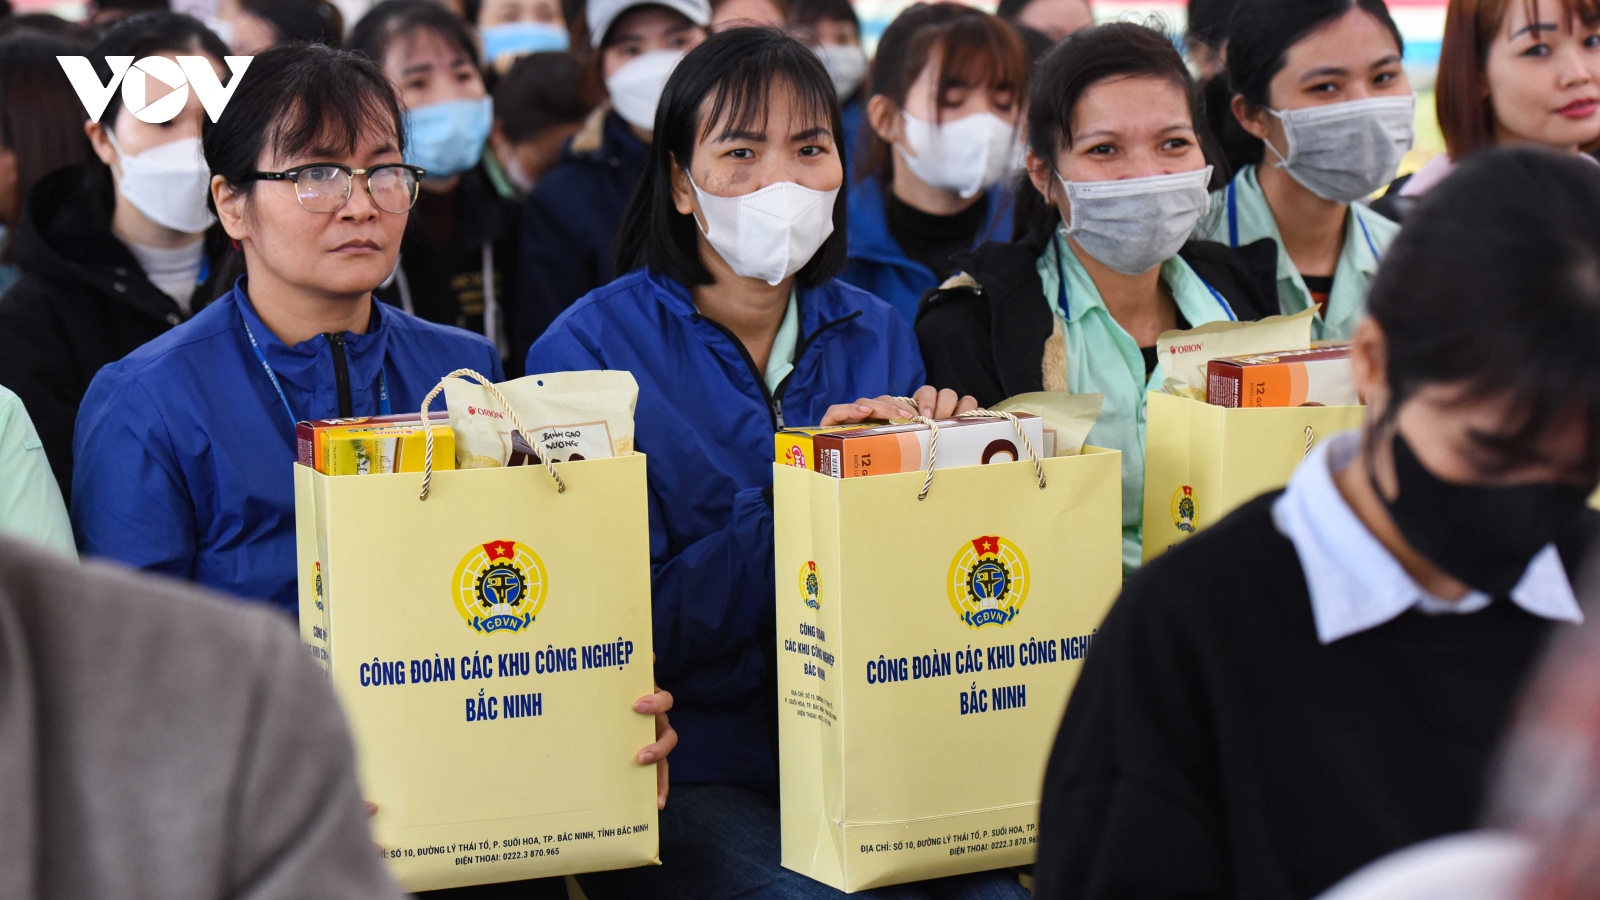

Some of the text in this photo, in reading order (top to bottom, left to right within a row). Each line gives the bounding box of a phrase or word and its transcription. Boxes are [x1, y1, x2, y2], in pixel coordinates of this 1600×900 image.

[1177, 343, 1202, 354] ORION
[1256, 381, 1266, 395] 12
[477, 407, 504, 419] ORION
[540, 427, 564, 443] BÁNH
[861, 453, 871, 467] 12
[486, 617, 518, 630] CĐVN
[976, 611, 1004, 624] CĐVN
[800, 622, 815, 638] CÔNG
[785, 638, 796, 653] CÁC
[797, 642, 810, 656] KHU
[360, 637, 634, 687] CÔNG ĐOÀN CÁC KHU CÔNG NGHIỆP
[866, 629, 1096, 684] CÔNG ĐOÀN CÁC KHU CÔNG NGHI
[804, 660, 816, 676] BẮC
[465, 688, 543, 722] BẮC NINH
[960, 682, 1027, 716] BẮC NINH
[390, 847, 402, 858] SỐ
[404, 849, 415, 858] 10,
[417, 845, 445, 857] ĐƯỜNG
[447, 843, 457, 854] LÝ
[458, 841, 477, 852] THÁI
[493, 840, 501, 849] P.
[502, 836, 521, 848] SUỐI
[522, 837, 541, 846] HOA,
[543, 835, 556, 844] TP.
[557, 832, 573, 843] BẮC
[574, 831, 596, 841] NINH,
[597, 827, 615, 838] TỈNH
[617, 825, 632, 836] BẮC
[633, 823, 649, 834] NINH
[860, 844, 874, 854] ĐỊA
[876, 841, 892, 852] CHỈ:
[893, 840, 904, 851] SỐ
[905, 841, 915, 850] 10,
[917, 837, 941, 848] ĐƯỜNG
[943, 834, 951, 844] LÝ
[953, 832, 969, 843] THÁI
[991, 826, 1007, 837] SUỐI
[1009, 825, 1025, 835] HOA,
[1026, 823, 1037, 832] TP.
[455, 847, 560, 866] ĐIỆN THOẠI: 0222.3 870.965
[949, 846, 965, 857] ĐIỆN
[967, 843, 990, 853] THOẠI:
[991, 839, 1013, 850] 0222.3
